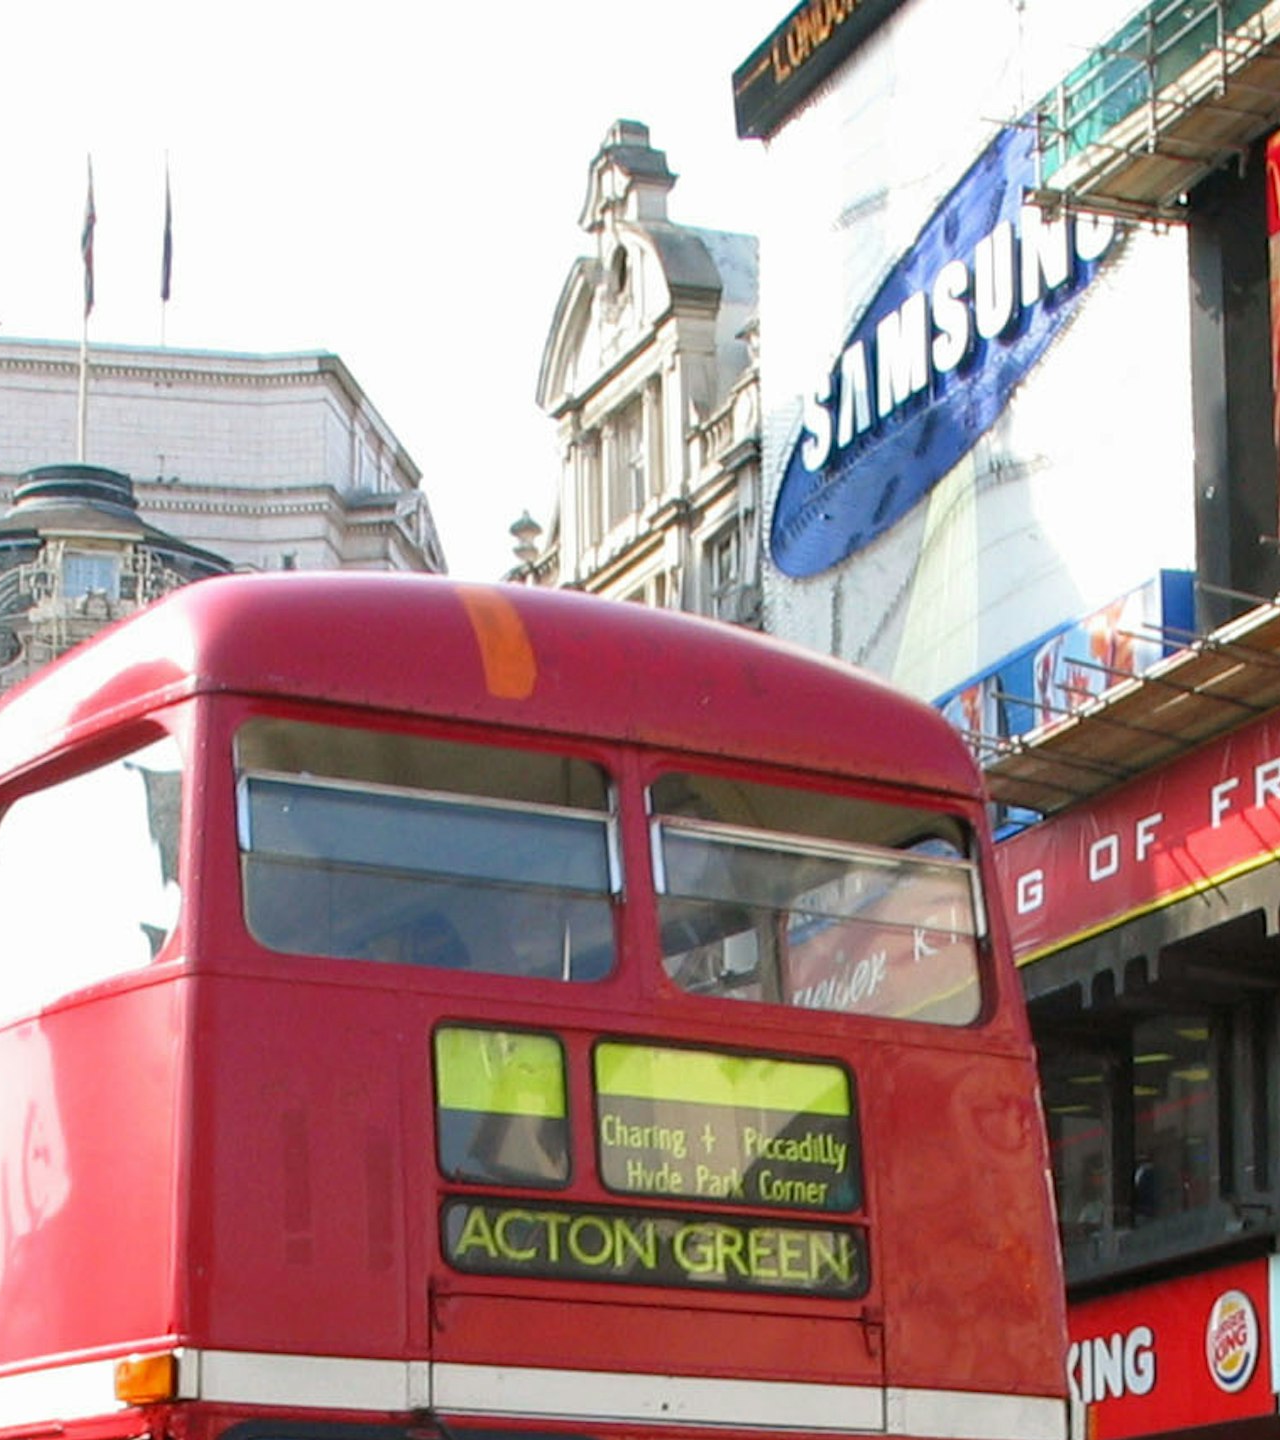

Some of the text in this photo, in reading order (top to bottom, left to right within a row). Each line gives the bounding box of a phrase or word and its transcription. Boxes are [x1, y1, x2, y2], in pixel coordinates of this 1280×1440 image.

[1089, 812, 1163, 882] OF
[601, 1114, 687, 1160] Charing
[743, 1126, 849, 1174] Piccadilly
[696, 1165, 745, 1199] Park
[759, 1171, 829, 1206] Corner
[455, 1205, 853, 1284] ACTON GREEN
